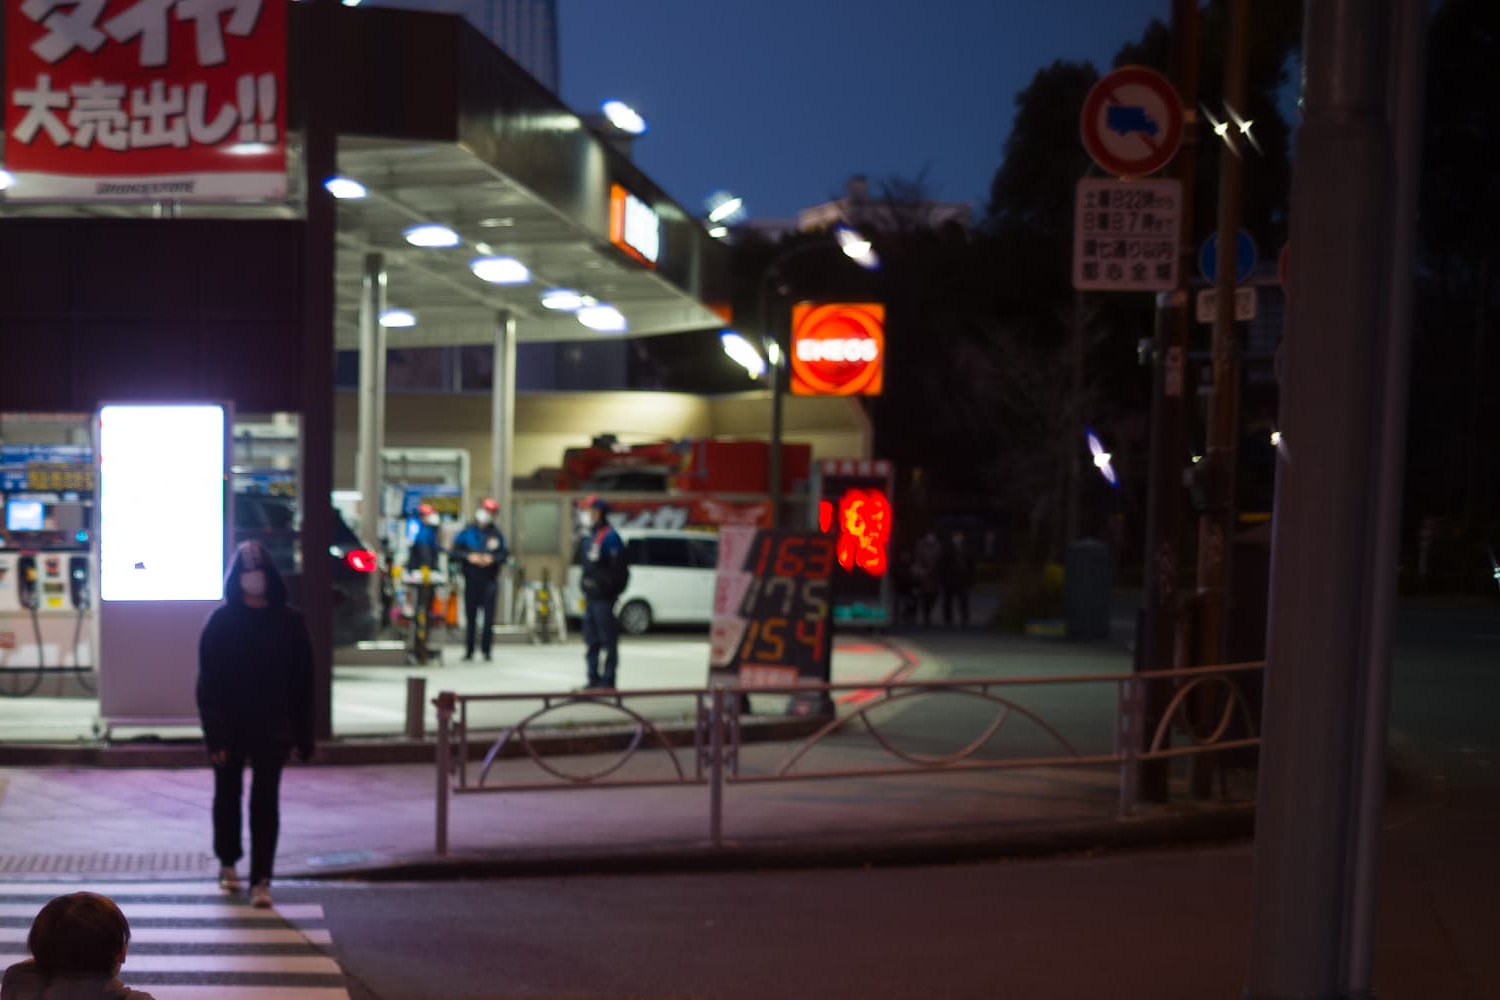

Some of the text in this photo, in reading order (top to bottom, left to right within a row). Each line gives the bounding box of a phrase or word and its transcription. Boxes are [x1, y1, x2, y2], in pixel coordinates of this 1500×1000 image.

[20, 0, 263, 67] タイヤ
[11, 73, 279, 151] 大売出し!!
[755, 537, 833, 578] 163
[743, 577, 829, 621] 175
[740, 617, 826, 663] 154
